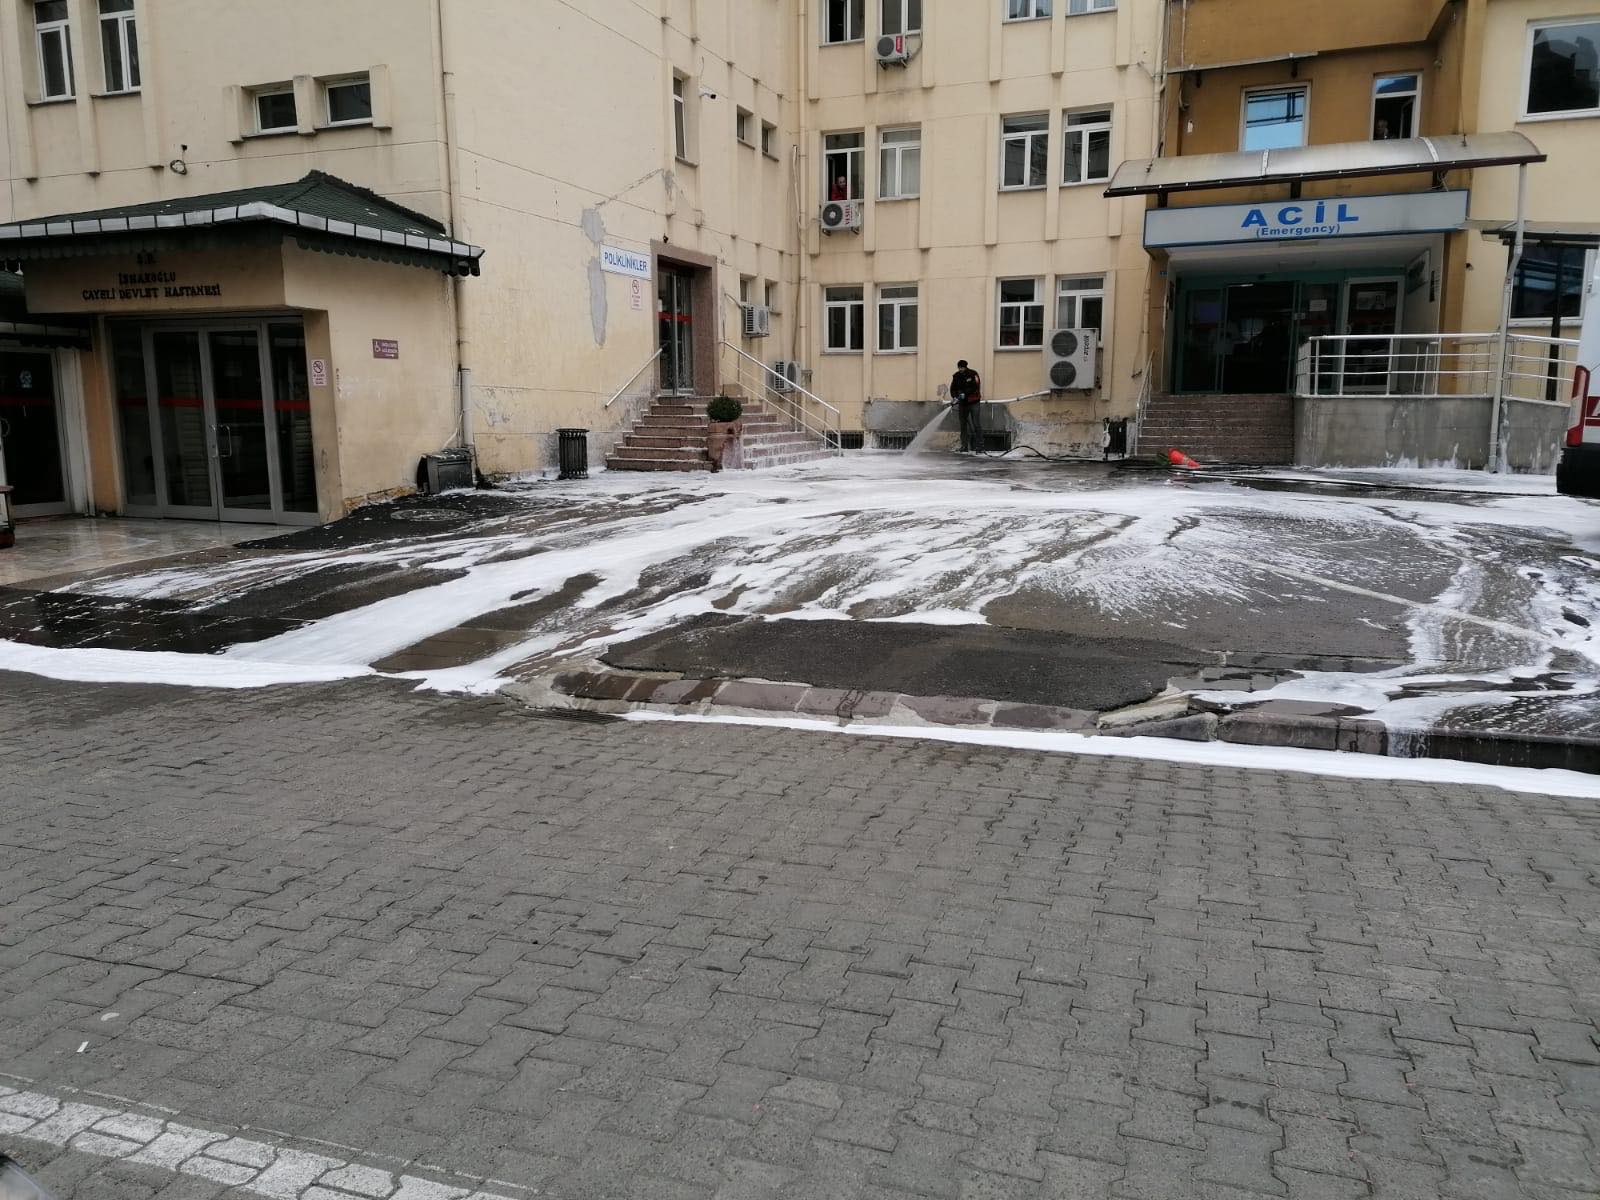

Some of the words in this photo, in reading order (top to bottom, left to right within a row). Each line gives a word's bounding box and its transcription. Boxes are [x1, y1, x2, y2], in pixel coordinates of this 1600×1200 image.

[1241, 201, 1359, 228] ACİL
[1256, 224, 1340, 238] (Emergency)
[604, 251, 647, 273] POLİKLİNİKLER
[119, 287, 159, 300] DEVLET
[164, 283, 222, 297] HASTANESİ
